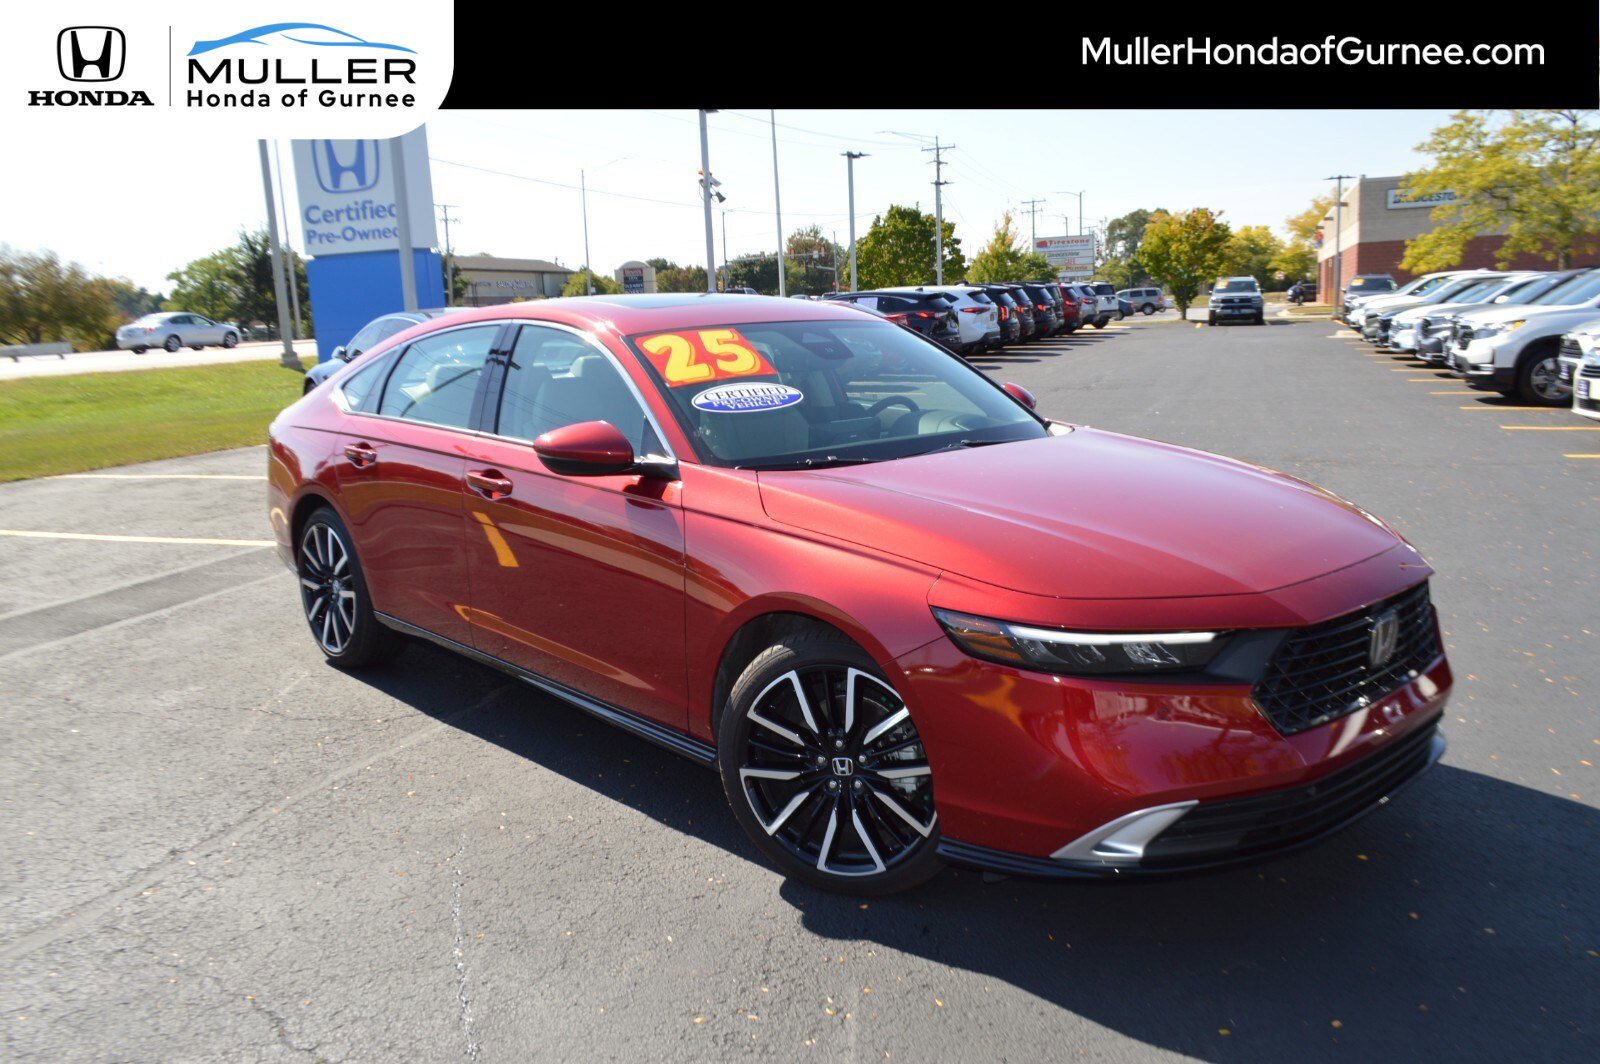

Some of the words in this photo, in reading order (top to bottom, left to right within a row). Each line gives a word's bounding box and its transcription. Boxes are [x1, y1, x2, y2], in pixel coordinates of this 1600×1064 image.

[642, 329, 760, 382] 25
[703, 387, 788, 401] CERTIFIED
[712, 393, 789, 407] PRE-OWNED
[727, 399, 783, 410] VEHICLE
